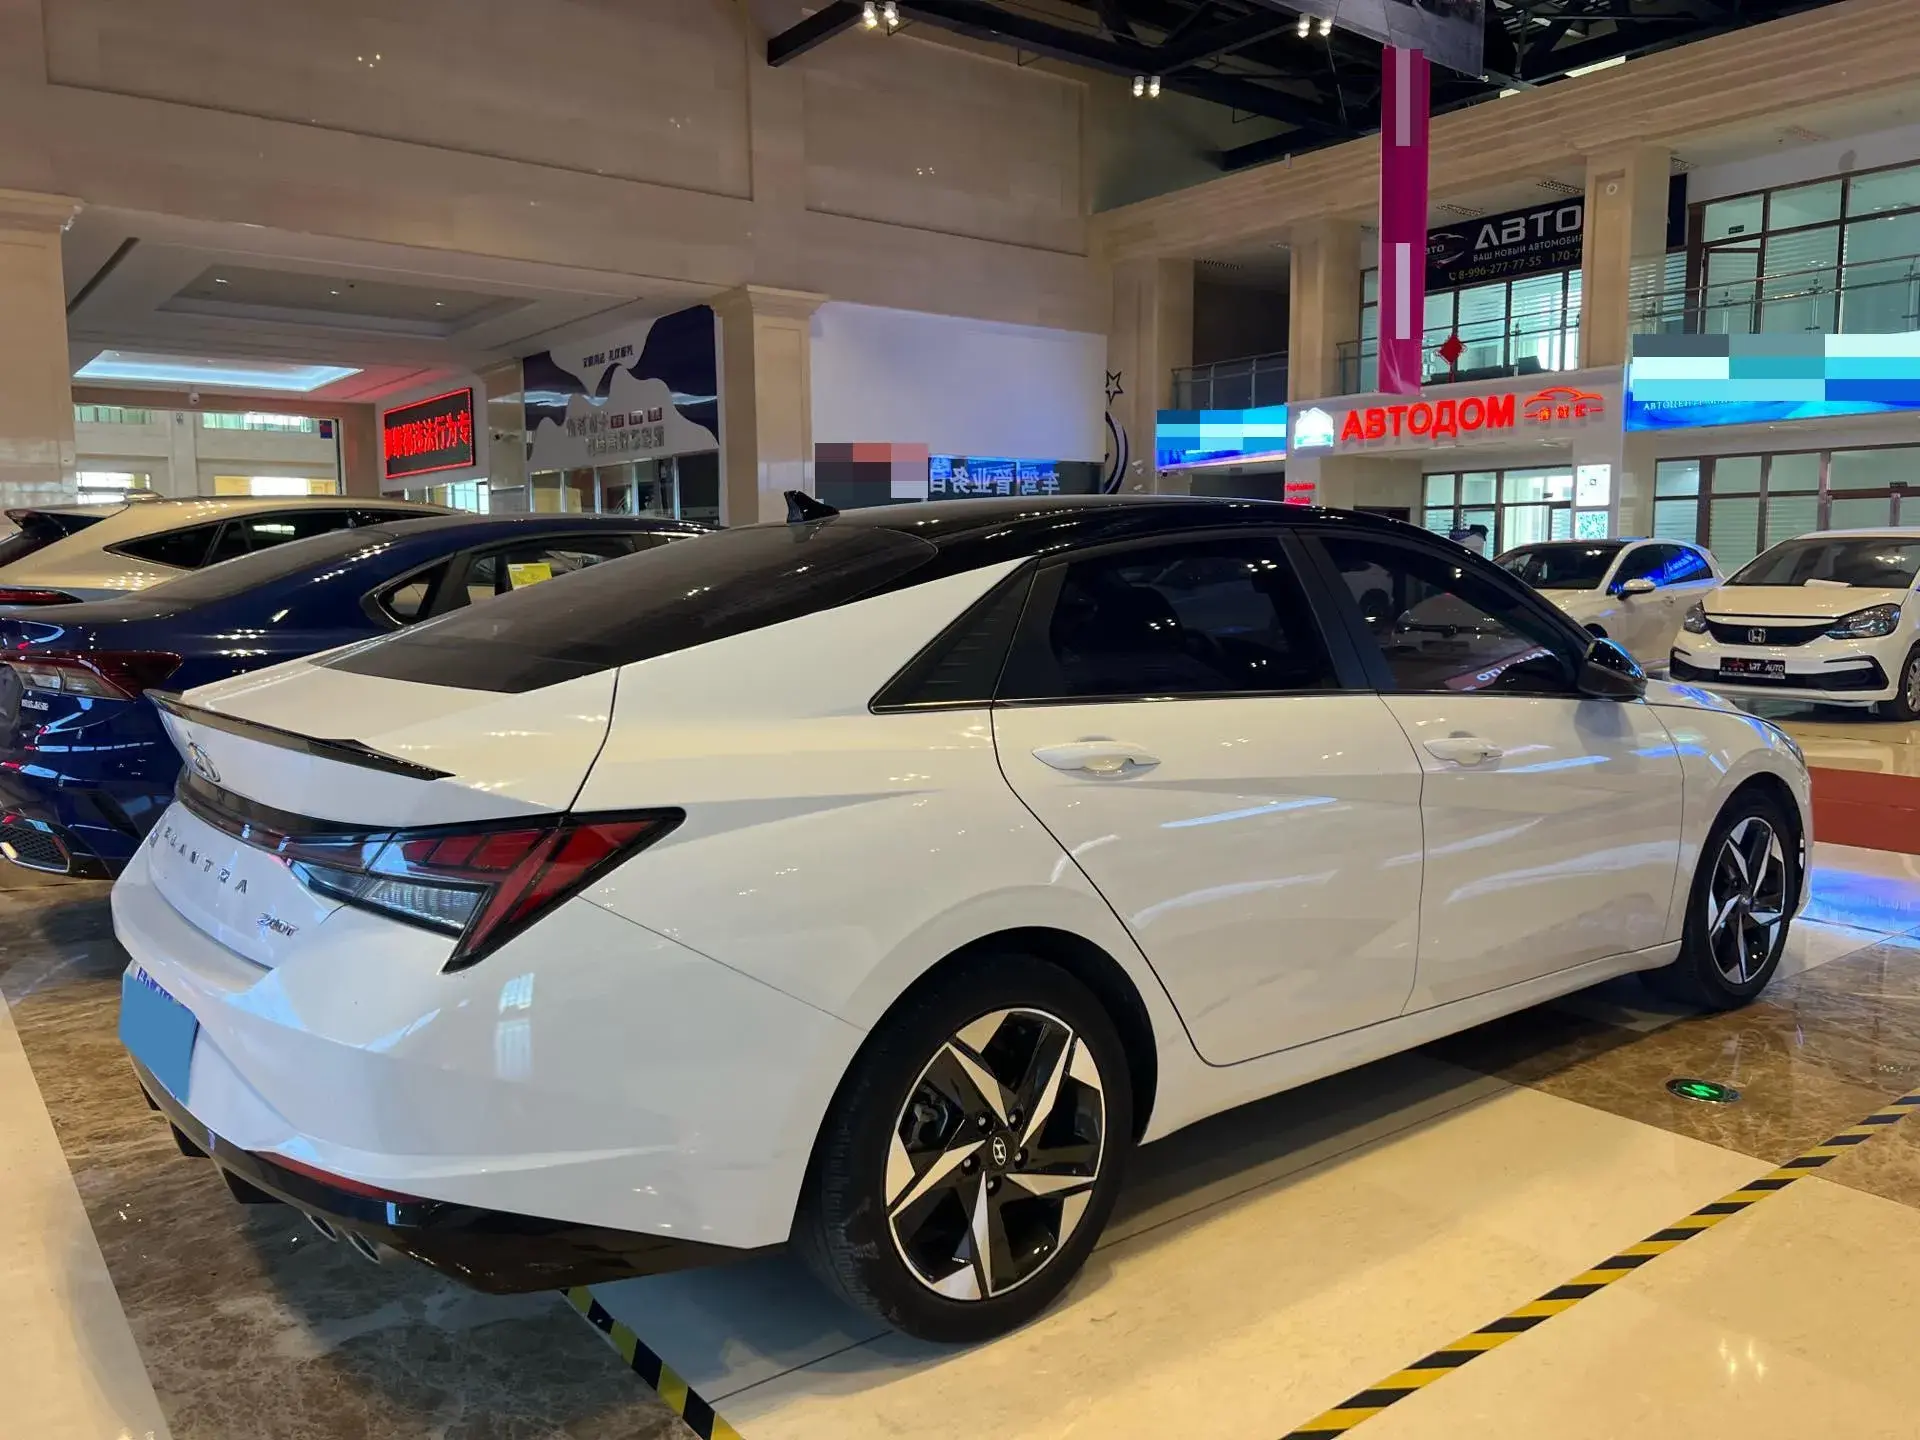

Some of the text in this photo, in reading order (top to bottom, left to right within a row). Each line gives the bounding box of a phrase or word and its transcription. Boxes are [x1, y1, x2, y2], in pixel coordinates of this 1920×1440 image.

[1474, 204, 1582, 250] АВТО
[1458, 255, 1542, 280] 8-996-277-77-55
[1473, 252, 1493, 263] ВАШ
[1494, 244, 1526, 258] НОВЫЙ
[1341, 394, 1516, 441] АВТОДОМ
[1765, 663, 1784, 672] AUTO
[163, 826, 249, 894] ELANTRA
